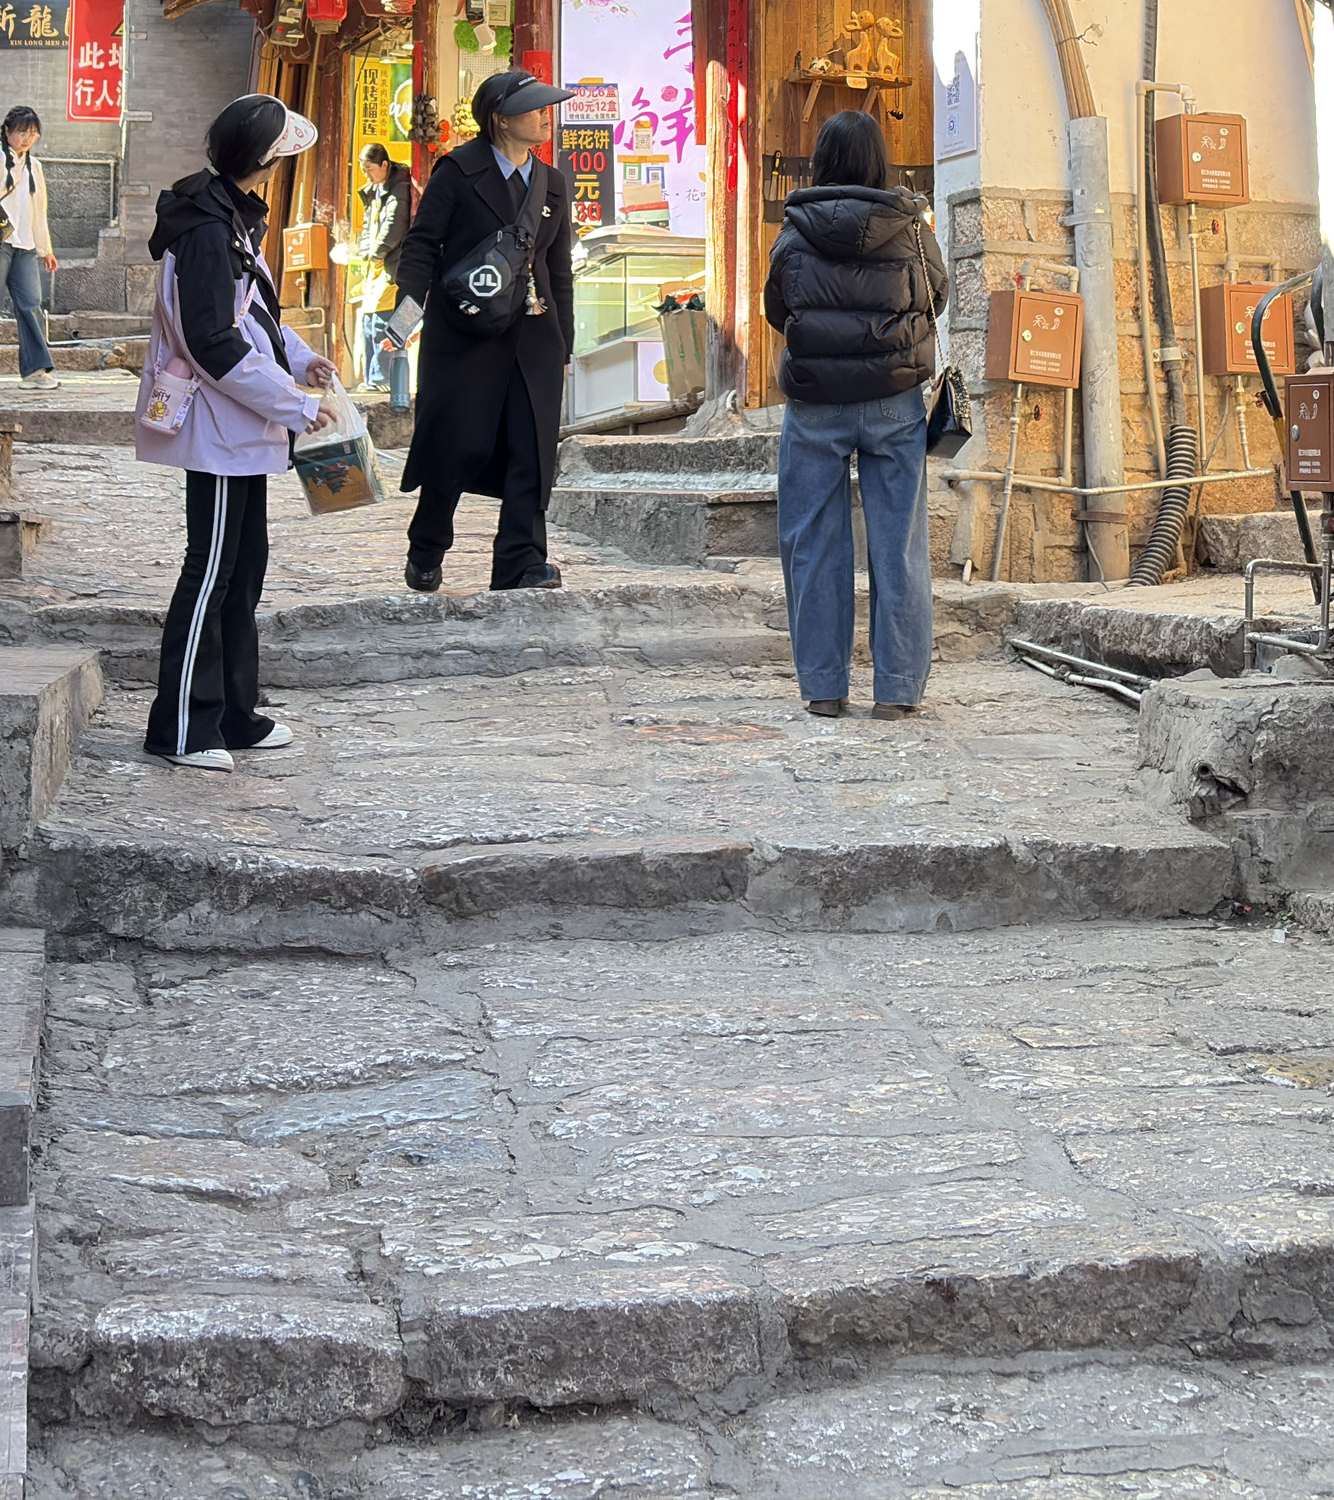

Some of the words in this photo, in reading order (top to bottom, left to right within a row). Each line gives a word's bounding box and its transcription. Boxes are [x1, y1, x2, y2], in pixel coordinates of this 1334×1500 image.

[74, 77, 123, 107] 行人
[362, 68, 378, 136] 现烤榴莲
[568, 85, 617, 98] 00元6盒
[567, 100, 617, 113] 100元12盒
[562, 129, 610, 150] 鲜花饼
[568, 151, 607, 172] 100
[574, 174, 600, 200] 元
[575, 201, 601, 222] 30
[473, 273, 497, 287] JL
